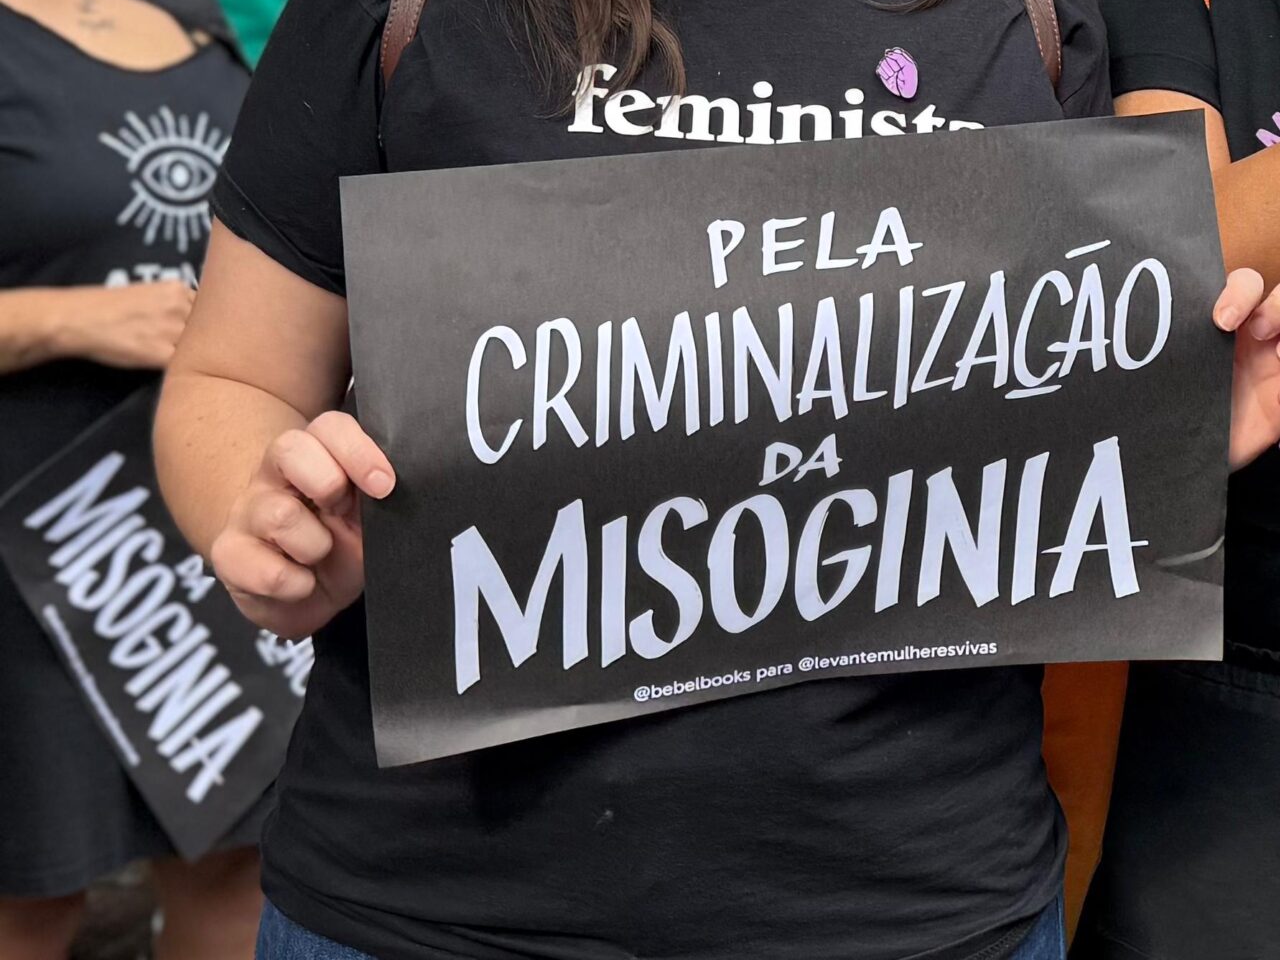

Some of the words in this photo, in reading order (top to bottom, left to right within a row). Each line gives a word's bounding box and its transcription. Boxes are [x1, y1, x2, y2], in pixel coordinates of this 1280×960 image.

[705, 206, 924, 289] PELA
[464, 240, 1174, 466] CRIMINALIZAÇÃO
[758, 433, 843, 487] DA
[23, 450, 264, 803] MISOGINIA
[449, 435, 1150, 696] MISOGINIA
[632, 669, 751, 703] @bebelbooks
[756, 661, 793, 683] para
[798, 640, 998, 672] @levantemulheresvivas
